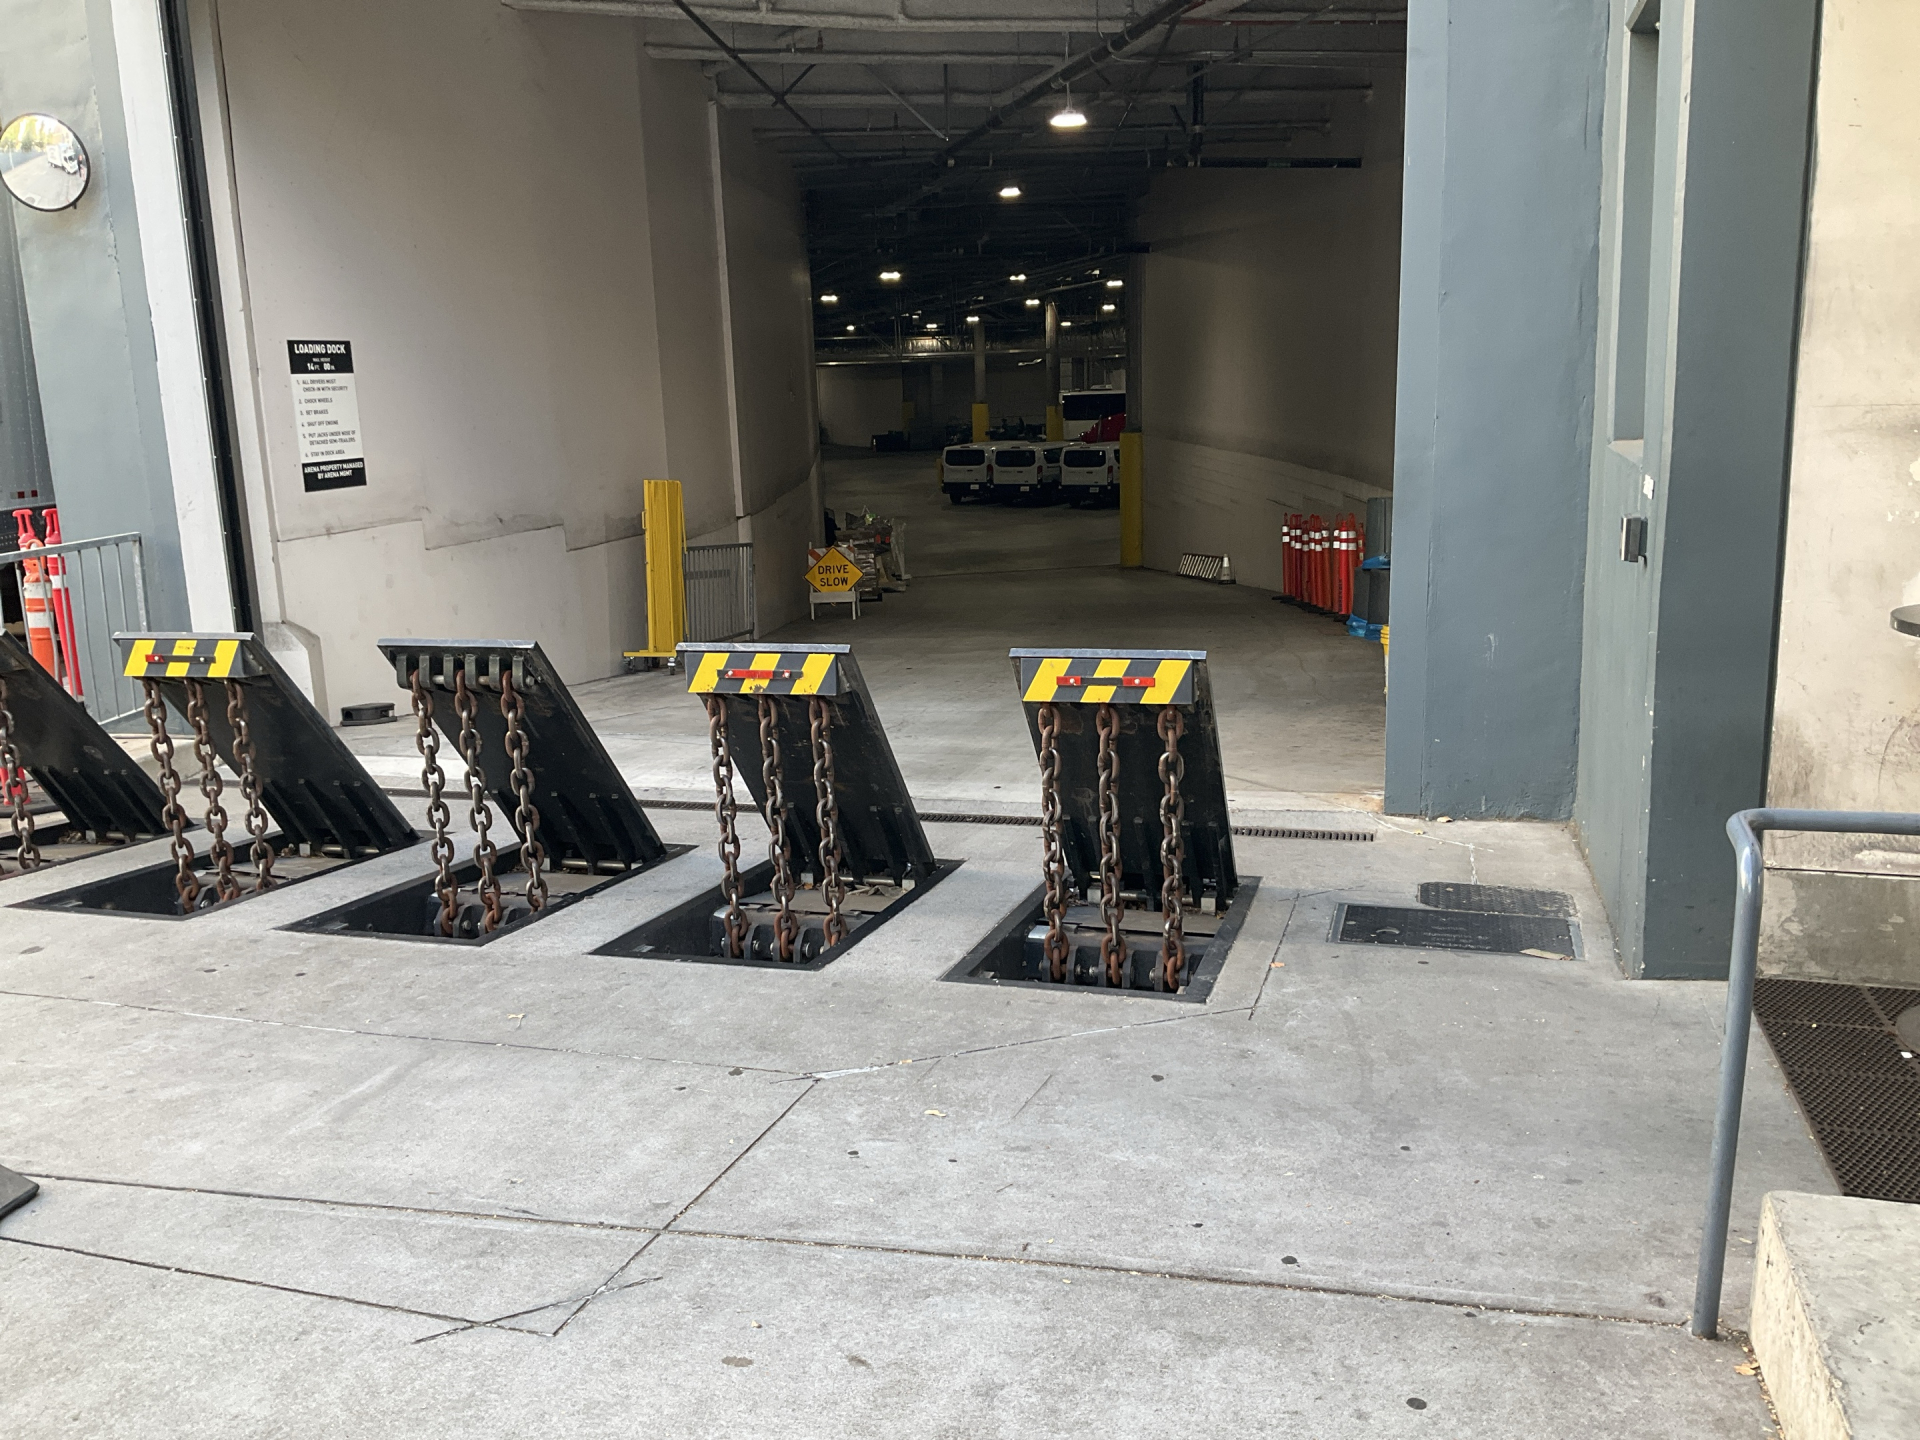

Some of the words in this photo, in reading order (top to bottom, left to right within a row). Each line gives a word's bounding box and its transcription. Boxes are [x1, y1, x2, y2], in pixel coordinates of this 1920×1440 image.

[294, 344, 326, 354] LOADING
[326, 344, 346, 354] DOCK
[818, 564, 849, 574] DRIVE
[820, 577, 848, 586] SLOW
